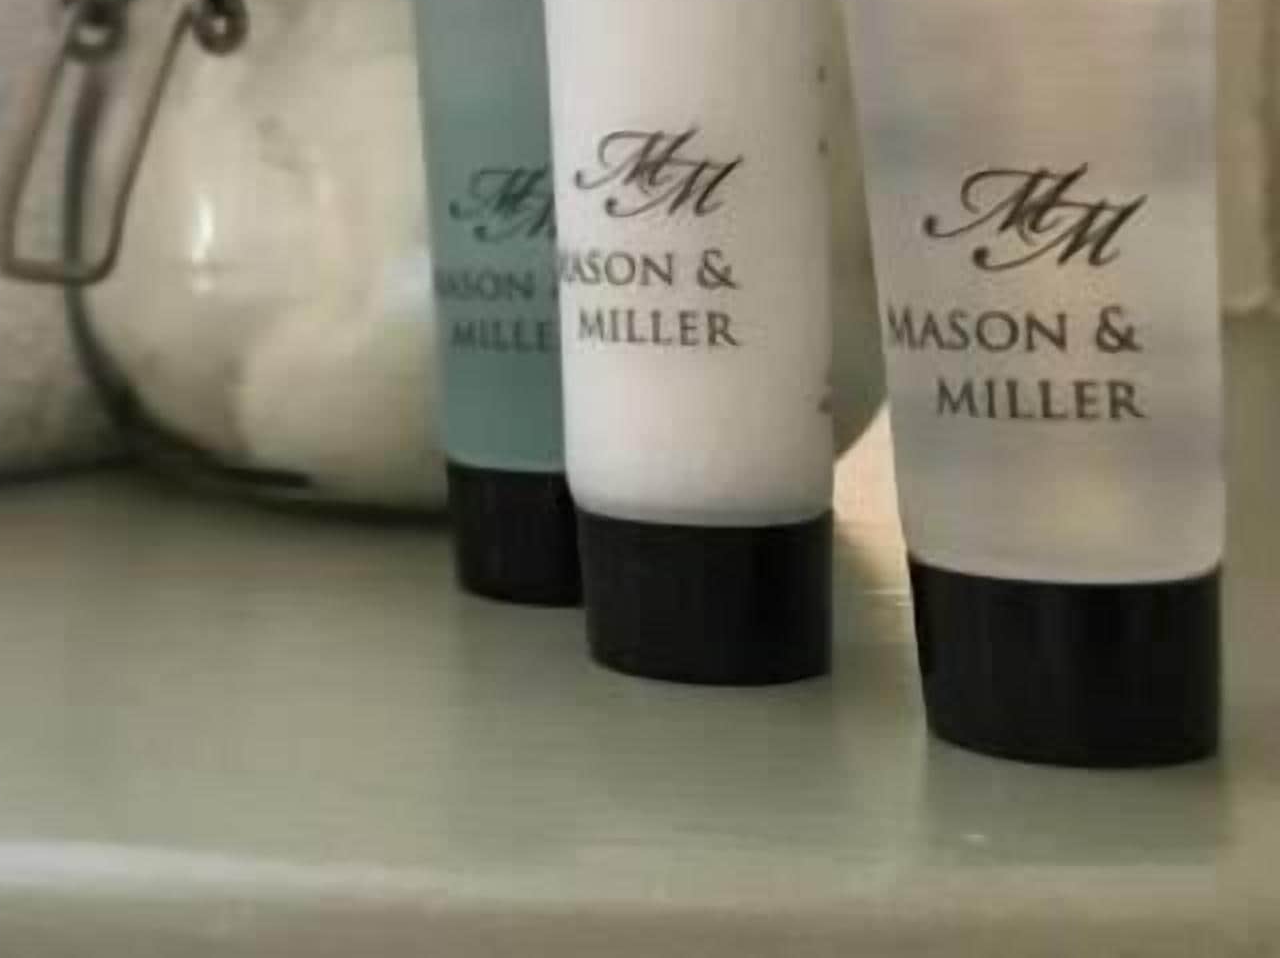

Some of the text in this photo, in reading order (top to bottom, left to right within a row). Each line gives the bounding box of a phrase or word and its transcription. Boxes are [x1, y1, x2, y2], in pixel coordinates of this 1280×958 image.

[696, 248, 741, 290] &
[578, 307, 744, 346] MILLER
[887, 305, 1144, 354] MASON &
[936, 376, 1146, 422] MILLER
